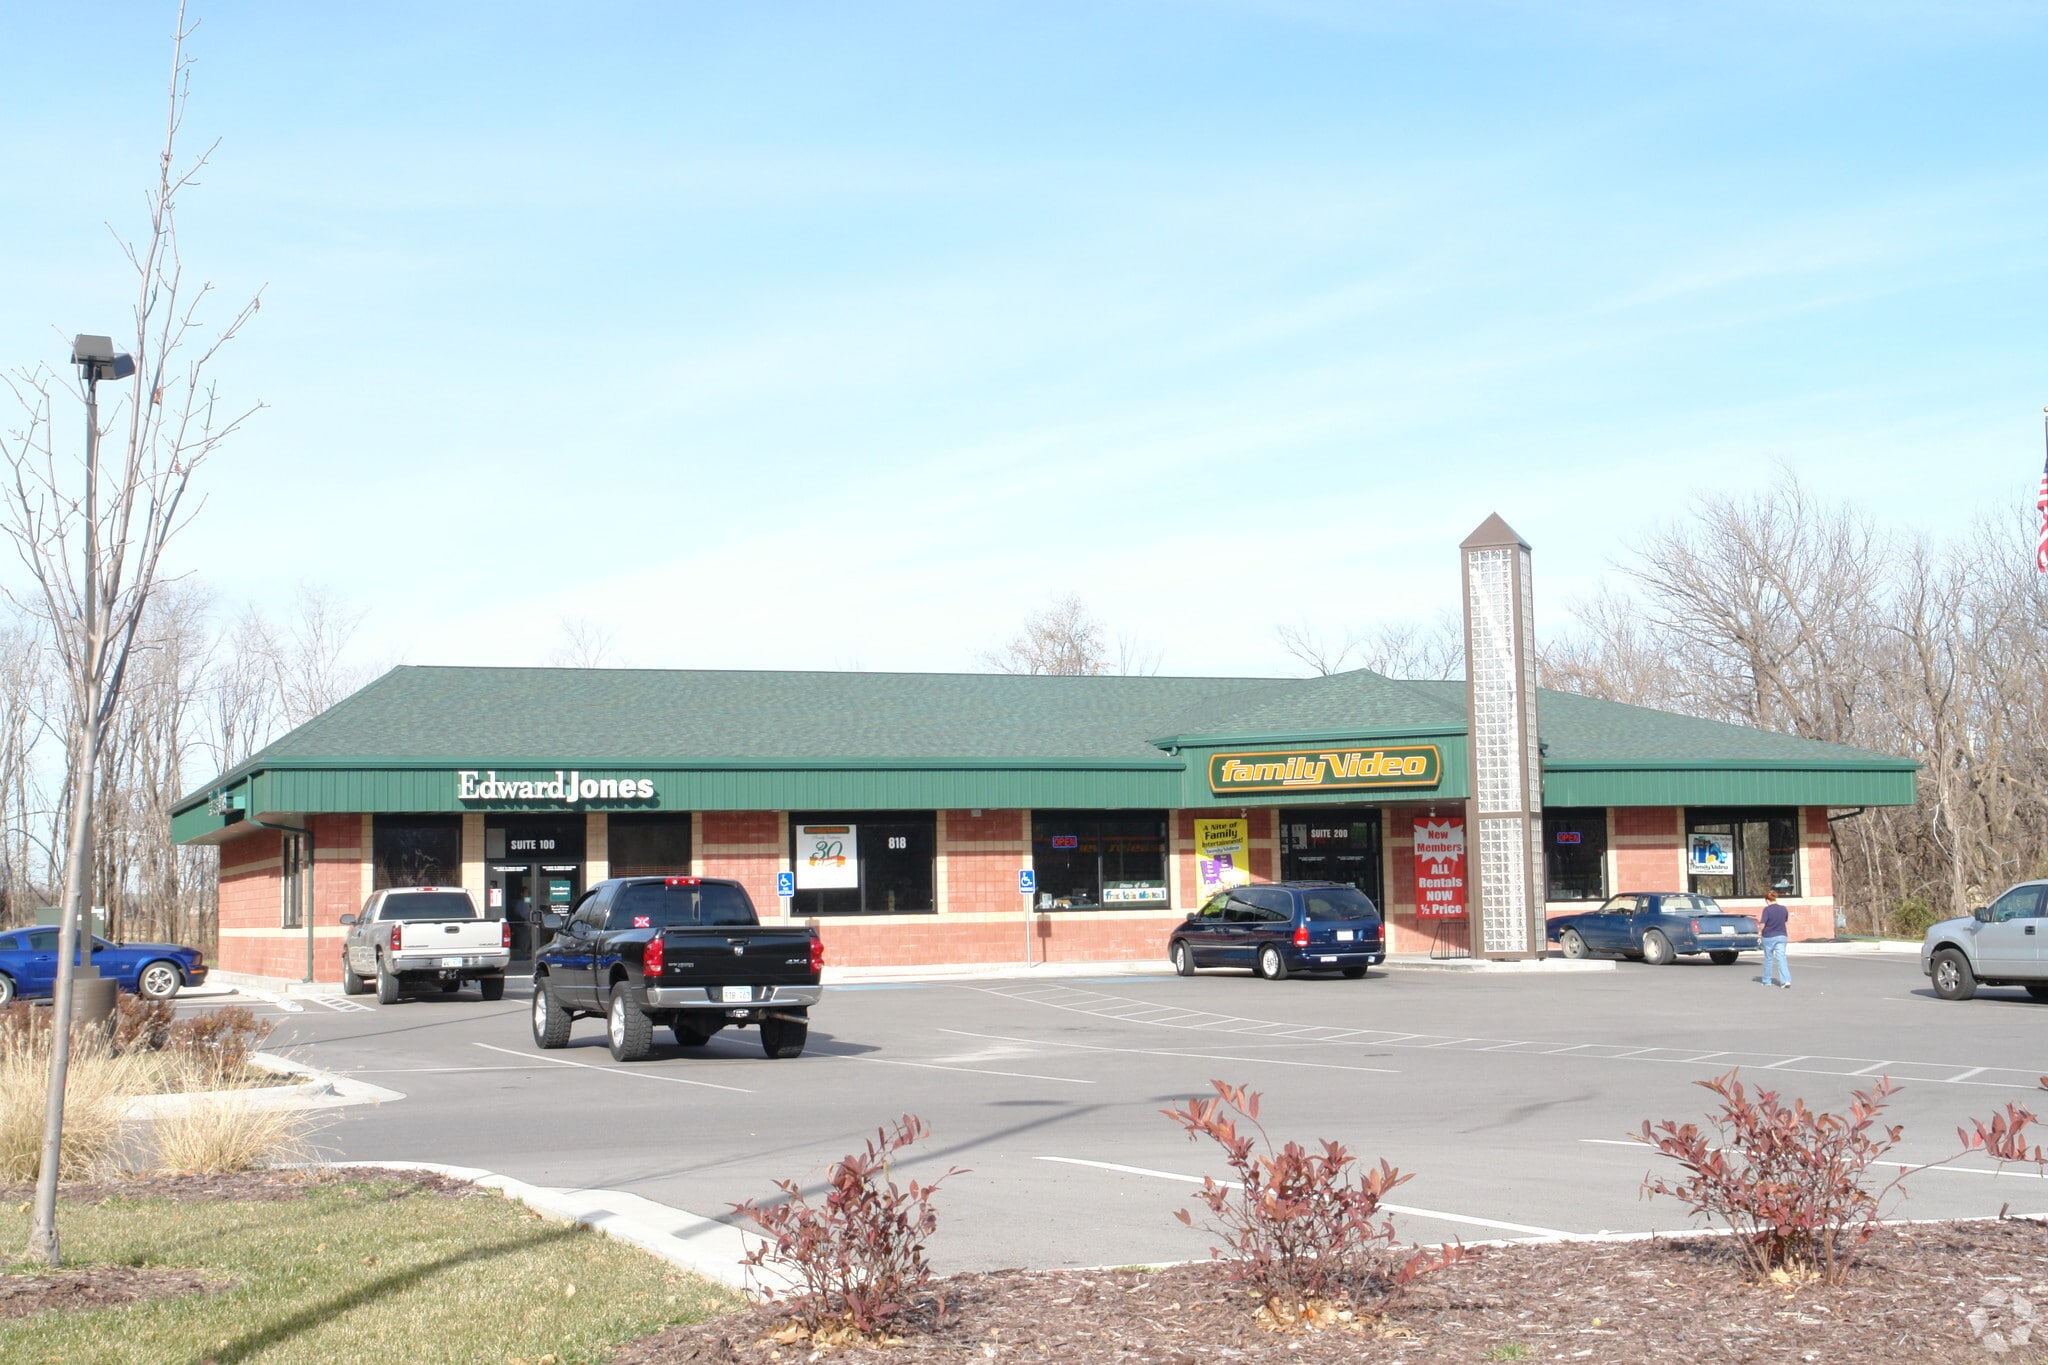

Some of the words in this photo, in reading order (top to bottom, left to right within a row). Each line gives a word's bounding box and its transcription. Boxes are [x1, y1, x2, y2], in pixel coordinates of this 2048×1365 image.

[1221, 757, 1325, 785] family
[1319, 752, 1427, 778] Video
[458, 771, 566, 799] Edward
[566, 771, 655, 802] Jones
[1205, 829, 1238, 840] Family
[1311, 829, 1331, 838] SUITE
[1334, 829, 1348, 838] 200
[1428, 830, 1448, 839] New
[511, 840, 536, 850] SUITE
[540, 840, 555, 850] 100
[888, 837, 906, 849] 818
[1055, 838, 1074, 847] OPEN
[1417, 843, 1462, 852] Members
[812, 840, 843, 861] 30
[1431, 864, 1450, 875] ALL
[1418, 877, 1463, 888] Rentals
[1426, 890, 1453, 901] NOW
[1432, 903, 1462, 915] Price
